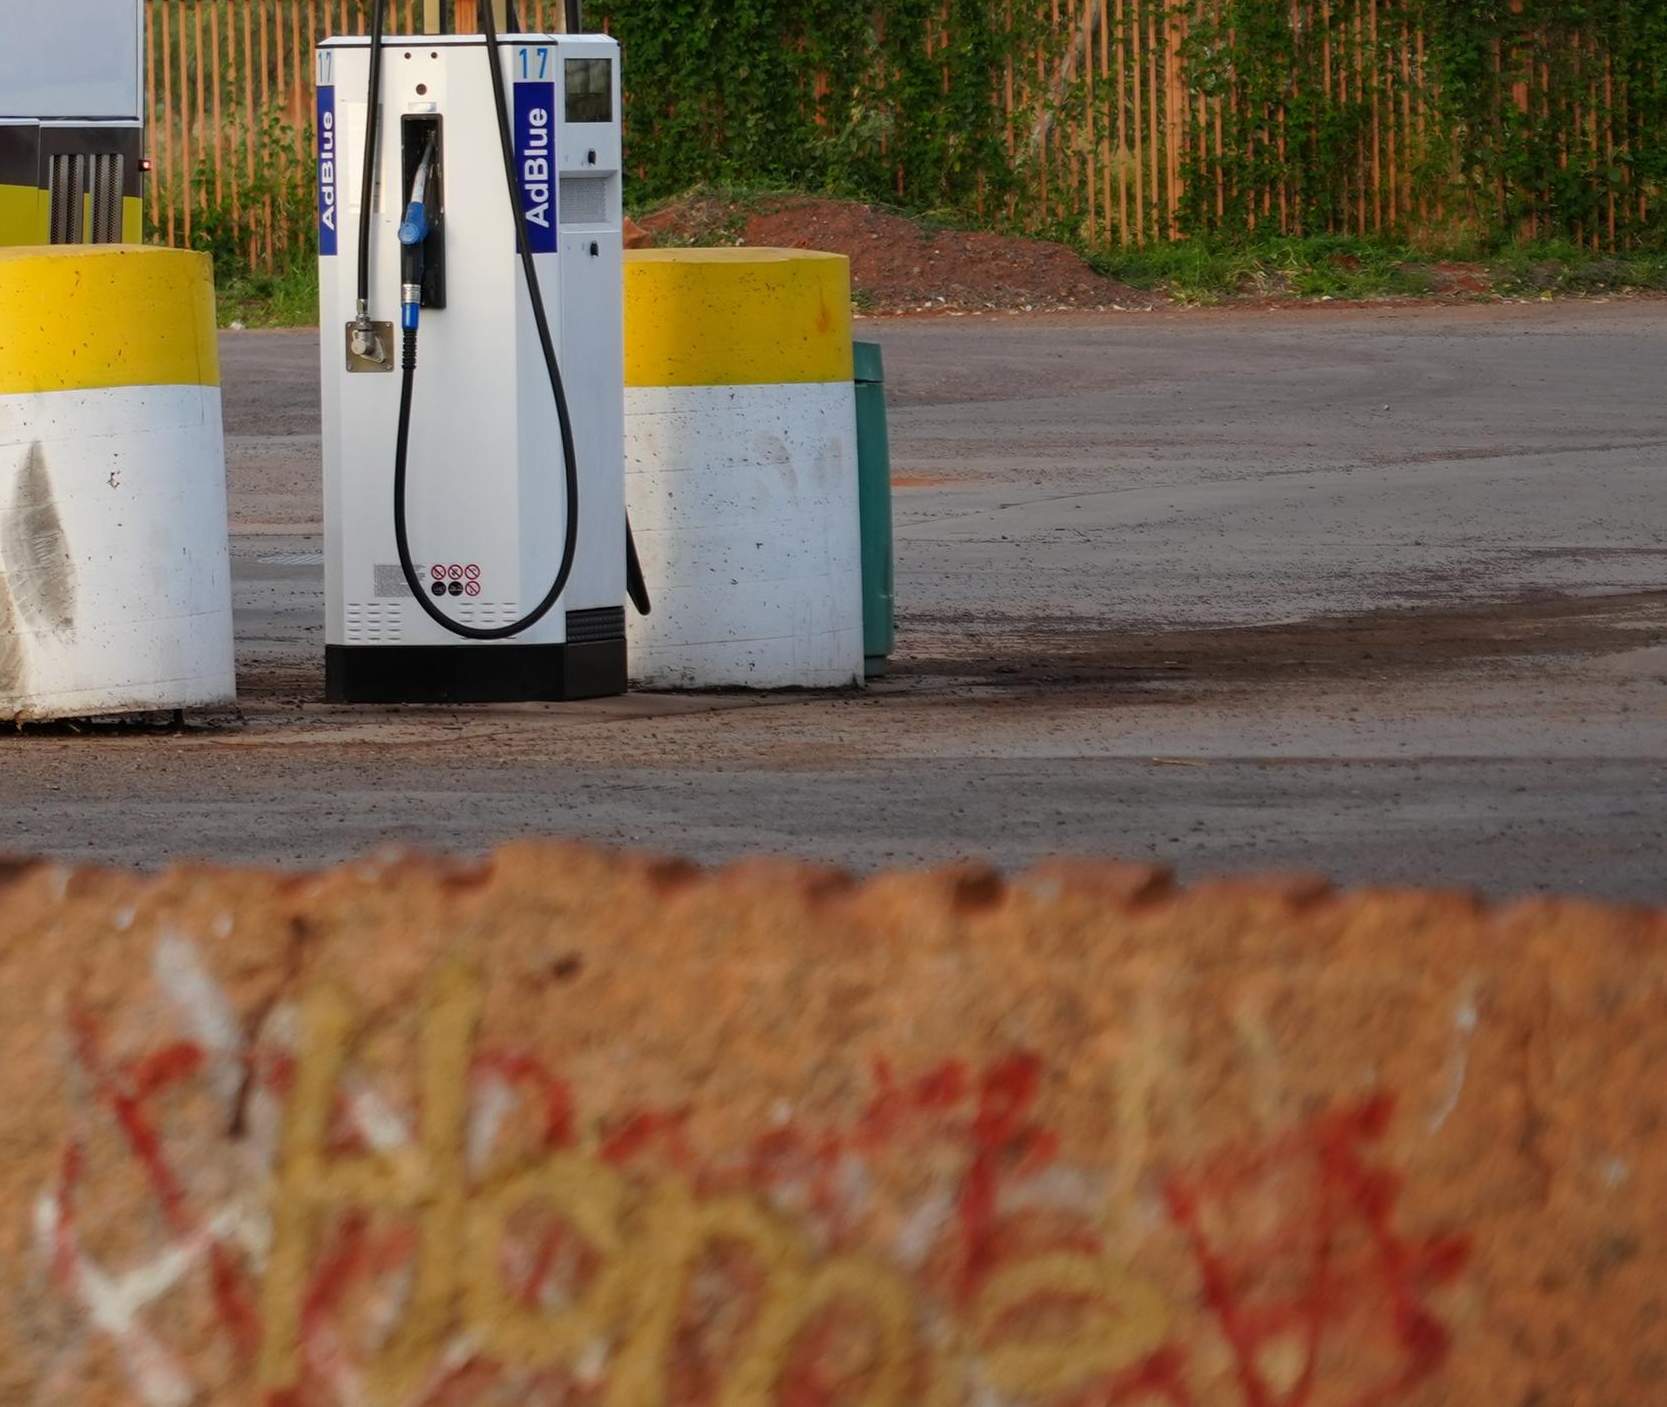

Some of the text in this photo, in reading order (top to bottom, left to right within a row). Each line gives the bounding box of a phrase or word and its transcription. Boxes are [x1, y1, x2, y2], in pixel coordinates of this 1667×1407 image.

[318, 51, 331, 83] 17
[519, 48, 548, 79] 17
[321, 111, 335, 230] AdBlue
[524, 108, 549, 228] AdBlue
